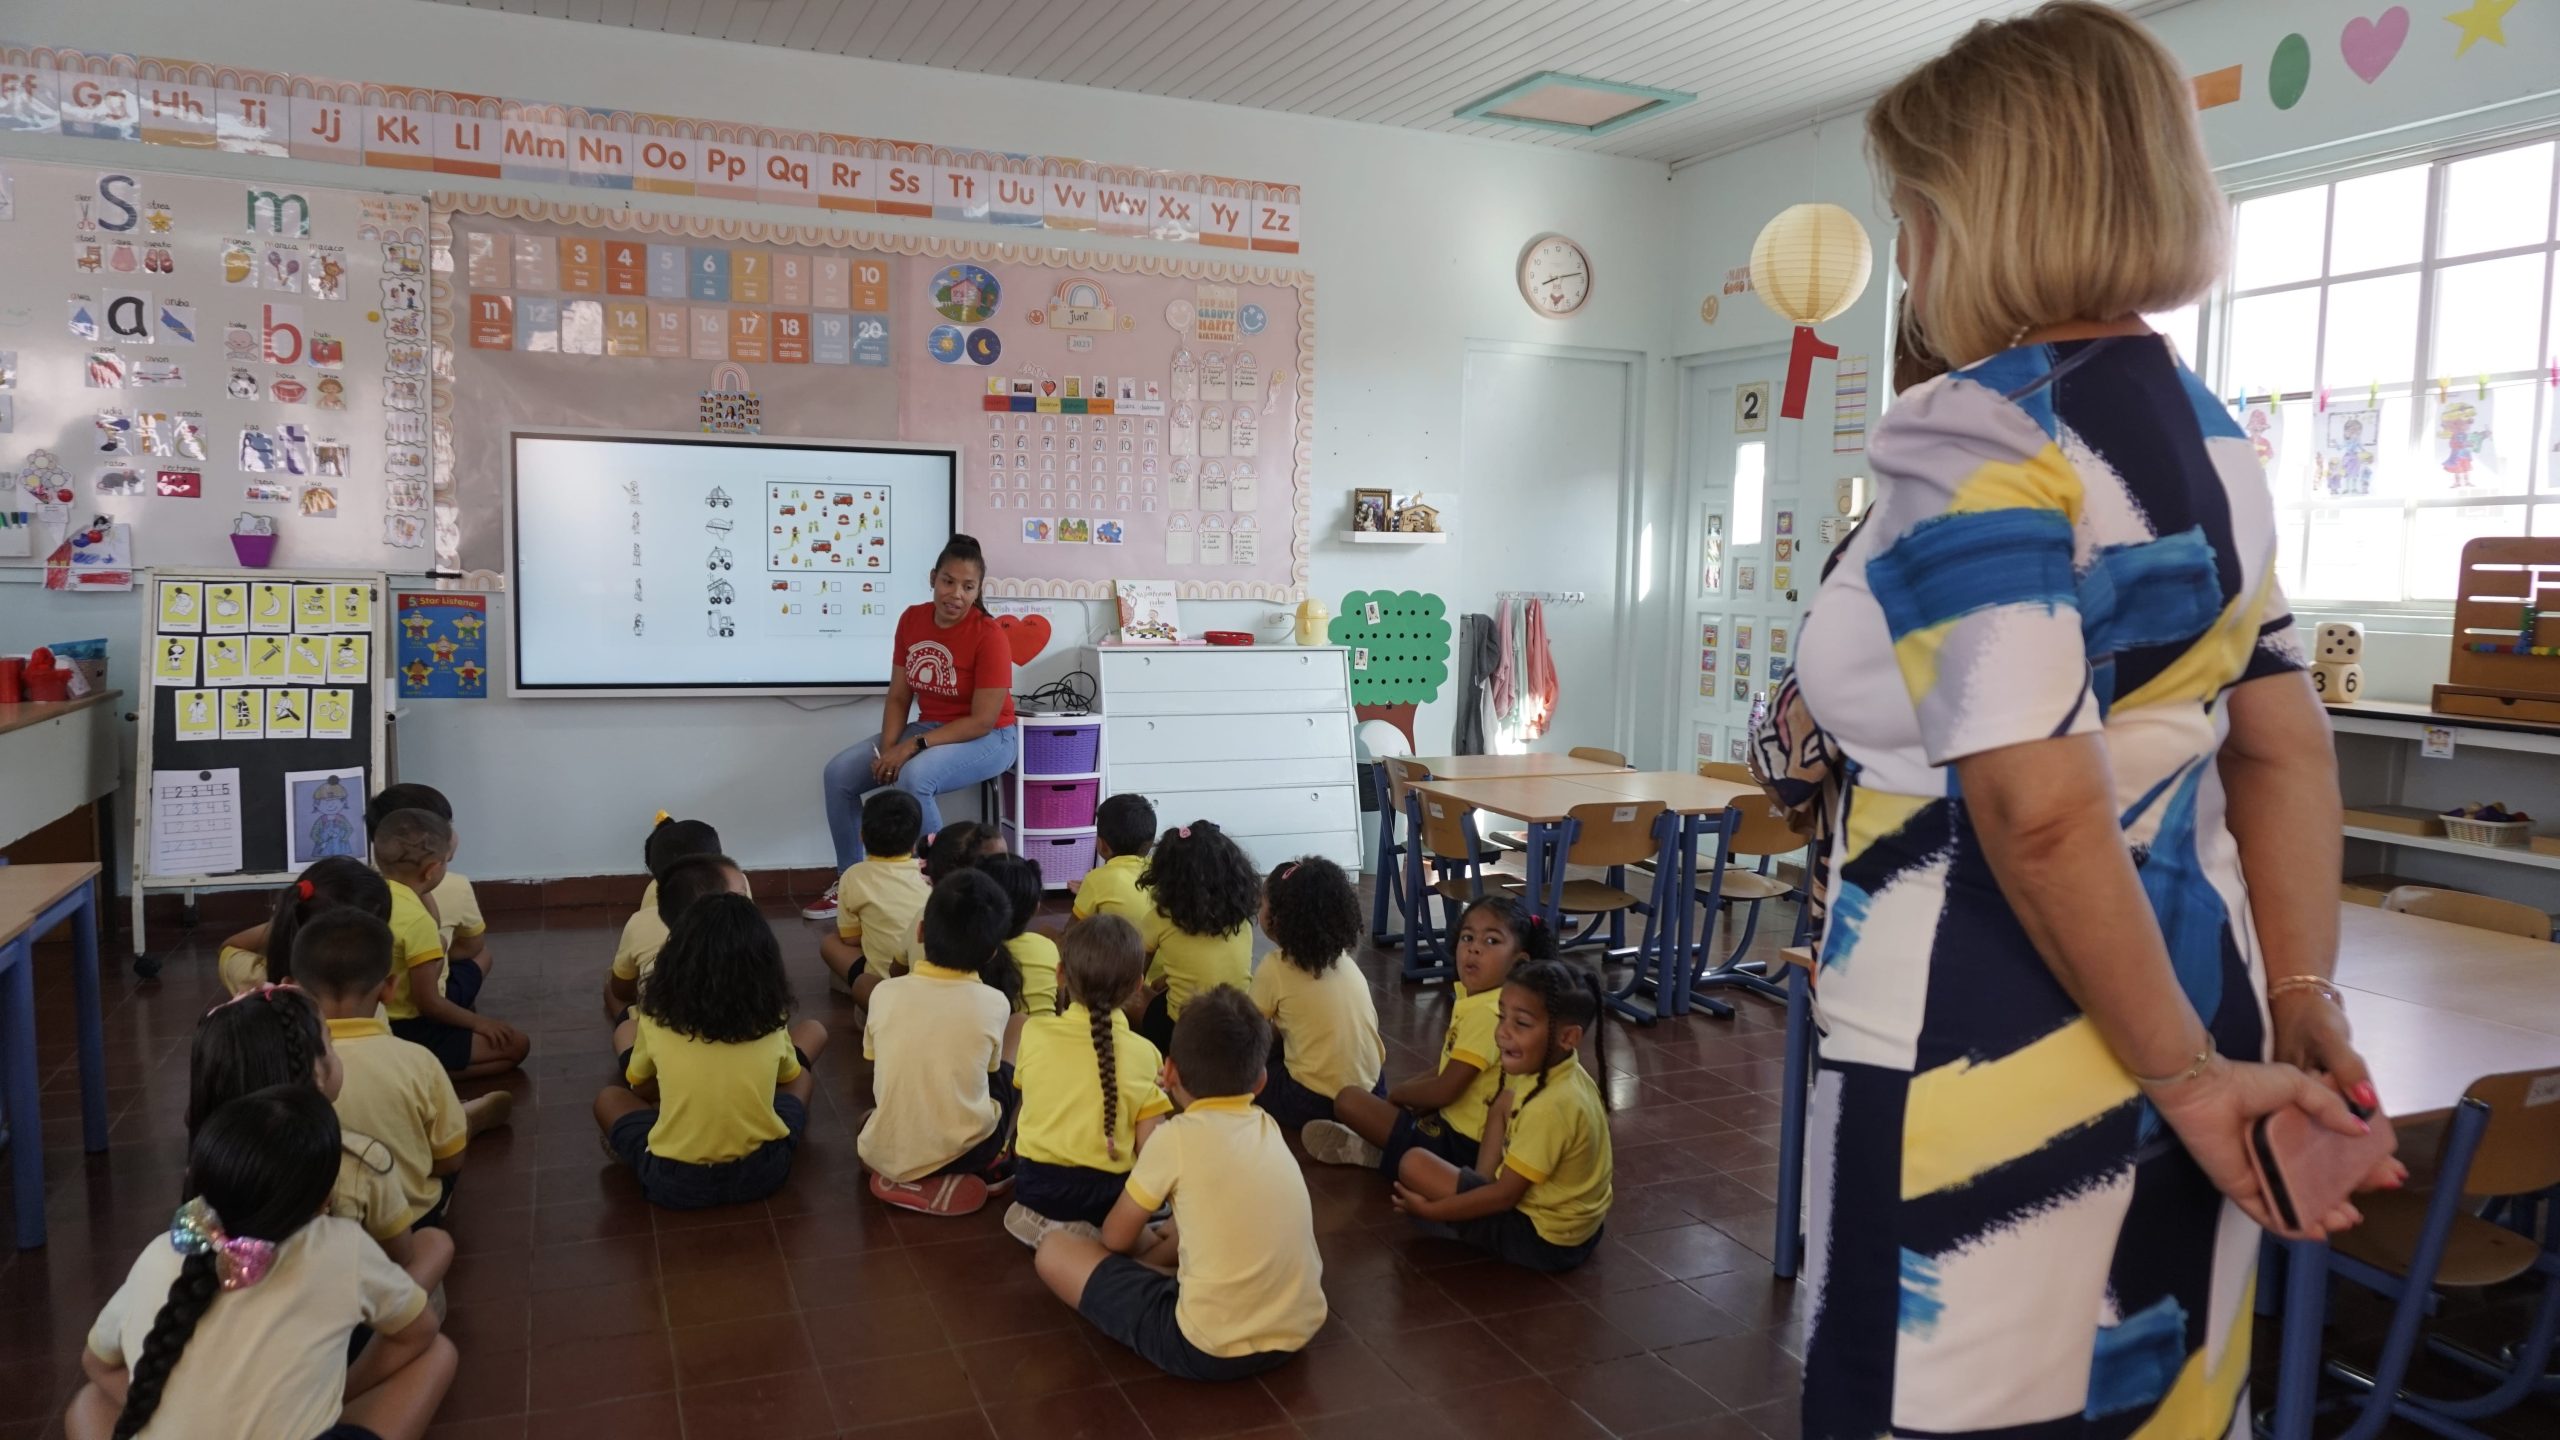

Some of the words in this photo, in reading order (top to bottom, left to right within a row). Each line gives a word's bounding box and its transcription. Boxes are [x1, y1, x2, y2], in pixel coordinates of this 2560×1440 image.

[72, 81, 128, 120] Gg
[152, 89, 204, 119] Hh
[311, 108, 341, 143] Jj
[377, 114, 421, 145] Kk
[455, 122, 480, 151] Ll
[504, 127, 565, 159] Mm
[579, 136, 622, 164] Nn
[642, 142, 687, 170] Oo
[707, 148, 746, 181] Pp
[766, 155, 809, 189] Qq
[831, 161, 861, 189] Rr
[889, 168, 920, 193] Ss
[948, 174, 975, 199] Tt
[998, 179, 1034, 205] Uu
[1053, 183, 1086, 209] Vv
[1099, 190, 1147, 216] Ww
[1158, 196, 1191, 221] Xx
[1211, 202, 1240, 233] Yy
[1261, 208, 1291, 232] Zz
[247, 190, 309, 235] m
[574, 245, 588, 263] 3
[617, 248, 633, 266] 4
[660, 252, 673, 270] 5
[703, 255, 716, 273] 6
[744, 257, 756, 274] 7
[785, 261, 798, 278] 8
[825, 263, 837, 280] 9
[859, 266, 881, 284] 10
[107, 296, 148, 337] a
[482, 302, 499, 320] 11
[527, 305, 547, 322] 12
[615, 310, 638, 328] 14
[658, 312, 677, 330] 15
[700, 316, 719, 333] 16
[739, 317, 759, 335] 17
[779, 319, 800, 336] 18
[821, 320, 840, 337] 19
[858, 322, 883, 339] 20
[1068, 310, 1089, 325] juni
[1198, 309, 1235, 319] GROOVY
[1198, 320, 1235, 332] HAPPY
[263, 304, 303, 365] b
[1743, 391, 1759, 420] 2
[1095, 420, 1103, 431] 2
[1121, 419, 1128, 430] 3
[992, 436, 1000, 448] 5
[1017, 436, 1024, 448] 6
[1043, 437, 1050, 447] 7
[1069, 438, 1075, 449] 8
[1095, 439, 1102, 451] 9
[1120, 440, 1131, 450] 10
[992, 455, 1003, 466] 12
[1015, 456, 1026, 467] 13
[420, 597, 439, 605] Star
[441, 597, 480, 607] Listener
[2313, 672, 2327, 693] 3
[2345, 672, 2357, 693] 6
[933, 686, 959, 696] TEACH
[175, 786, 183, 798] 2
[191, 785, 199, 798] 3
[206, 784, 214, 796] 4
[222, 783, 230, 795] 5
[175, 804, 184, 816] 2
[191, 802, 199, 814] 3
[207, 801, 215, 814] 4
[223, 801, 231, 813] 5
[176, 821, 185, 833] 2
